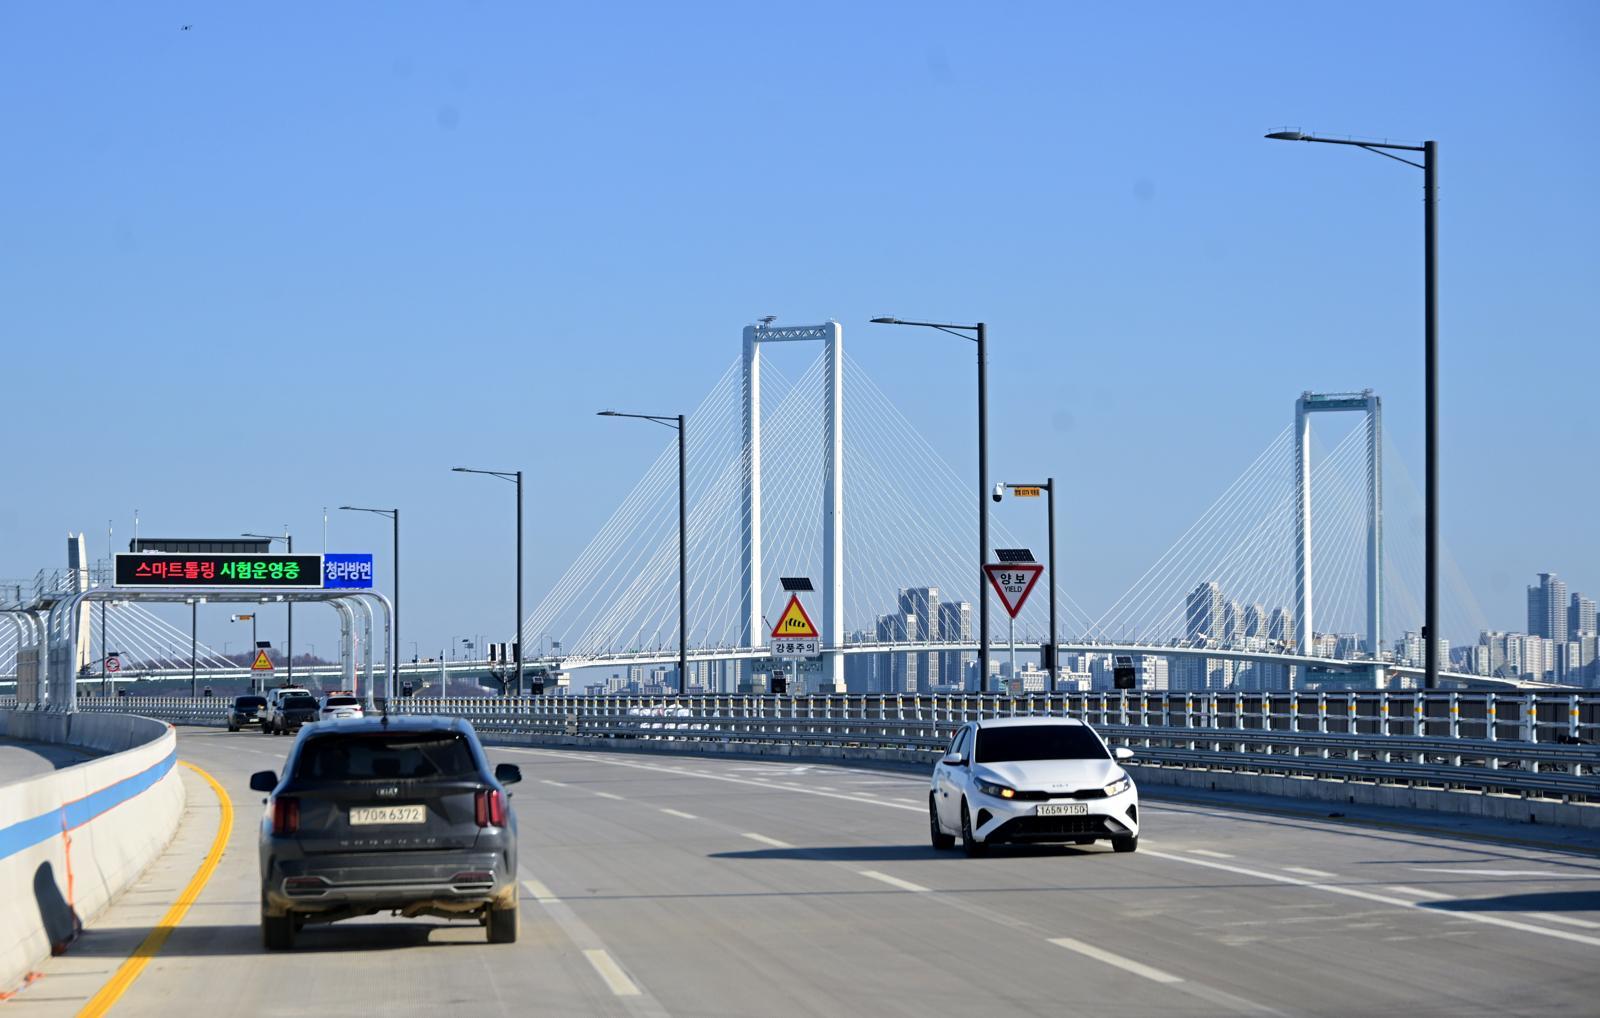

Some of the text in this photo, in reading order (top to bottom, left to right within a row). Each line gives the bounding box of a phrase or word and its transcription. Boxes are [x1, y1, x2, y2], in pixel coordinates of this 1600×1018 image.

[135, 561, 300, 579] 스마트톨링 시험운영중
[325, 561, 372, 580] 청라방면
[1000, 573, 1026, 585] 양보
[1004, 585, 1023, 593] YIELD
[776, 643, 815, 654] 강풍주의
